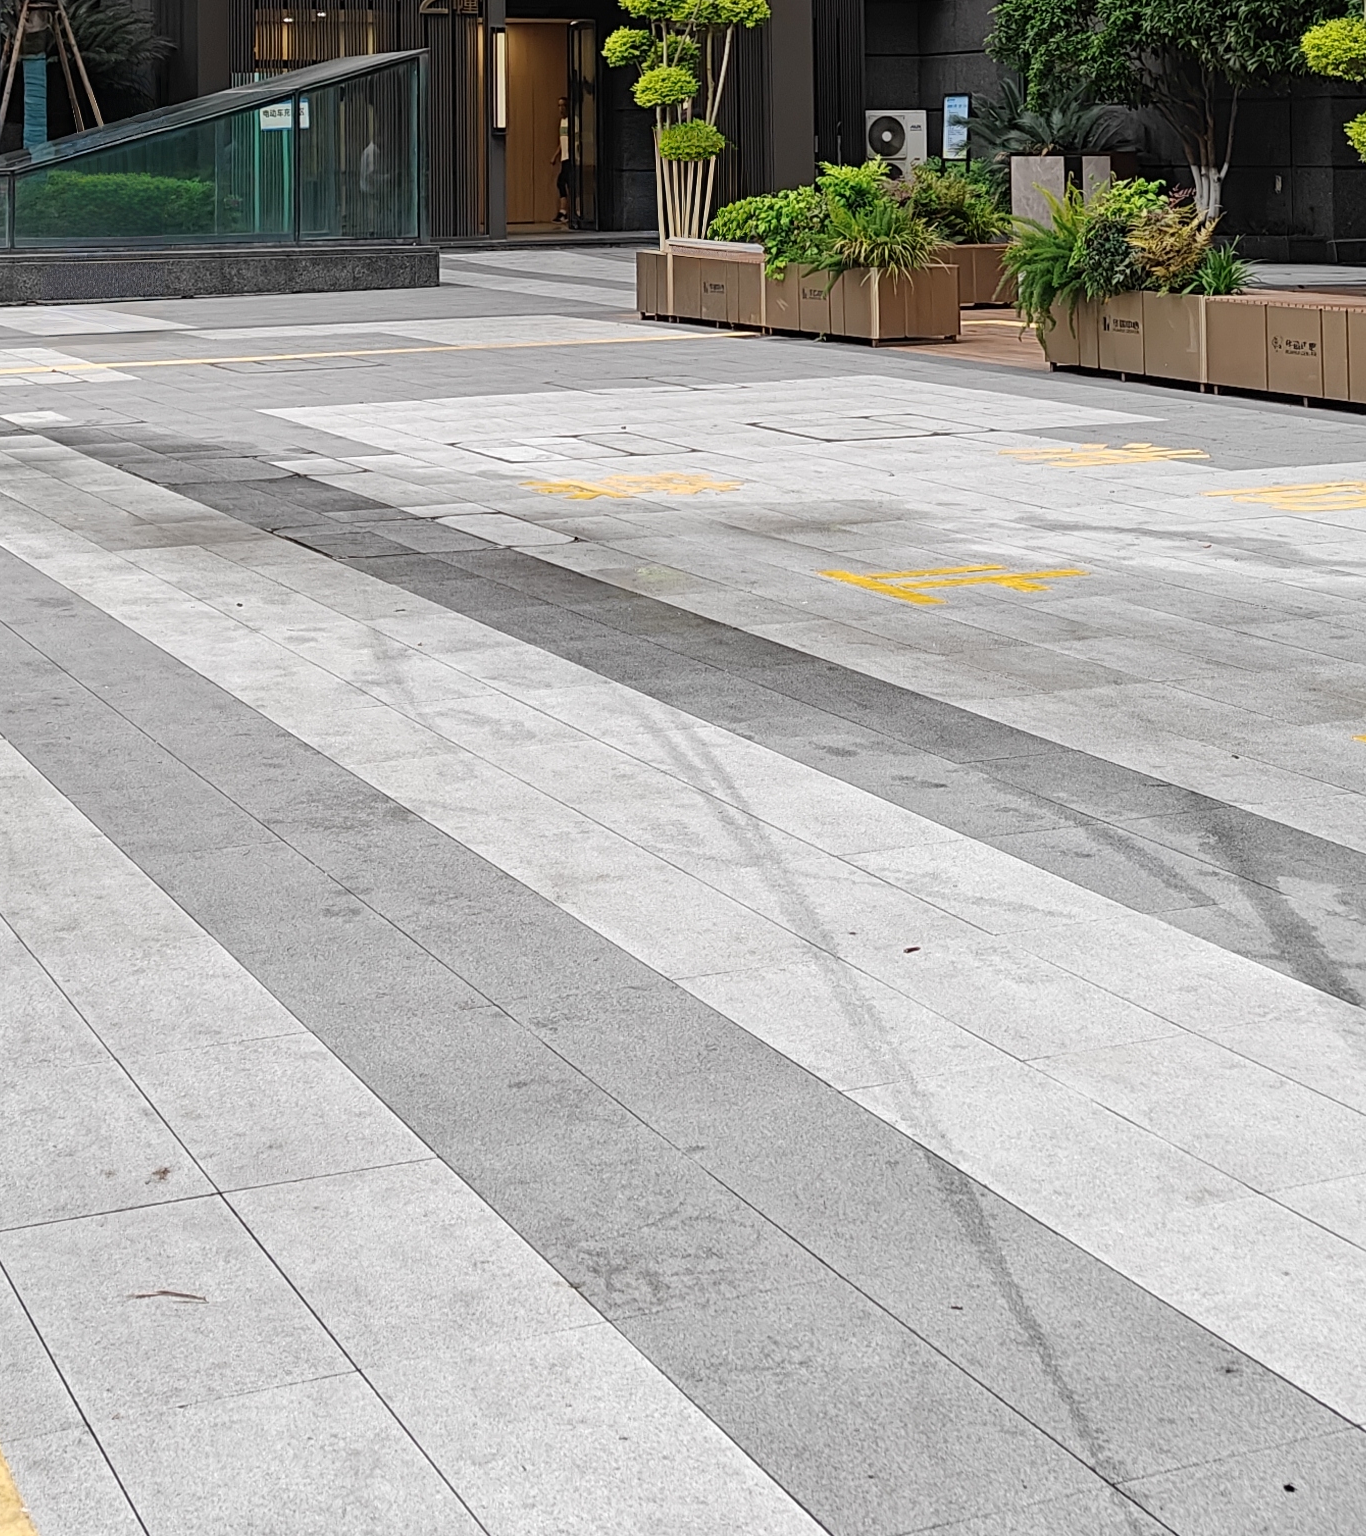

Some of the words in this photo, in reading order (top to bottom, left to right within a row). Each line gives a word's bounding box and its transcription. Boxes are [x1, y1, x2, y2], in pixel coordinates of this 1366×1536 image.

[262, 107, 305, 118] 电动车充区
